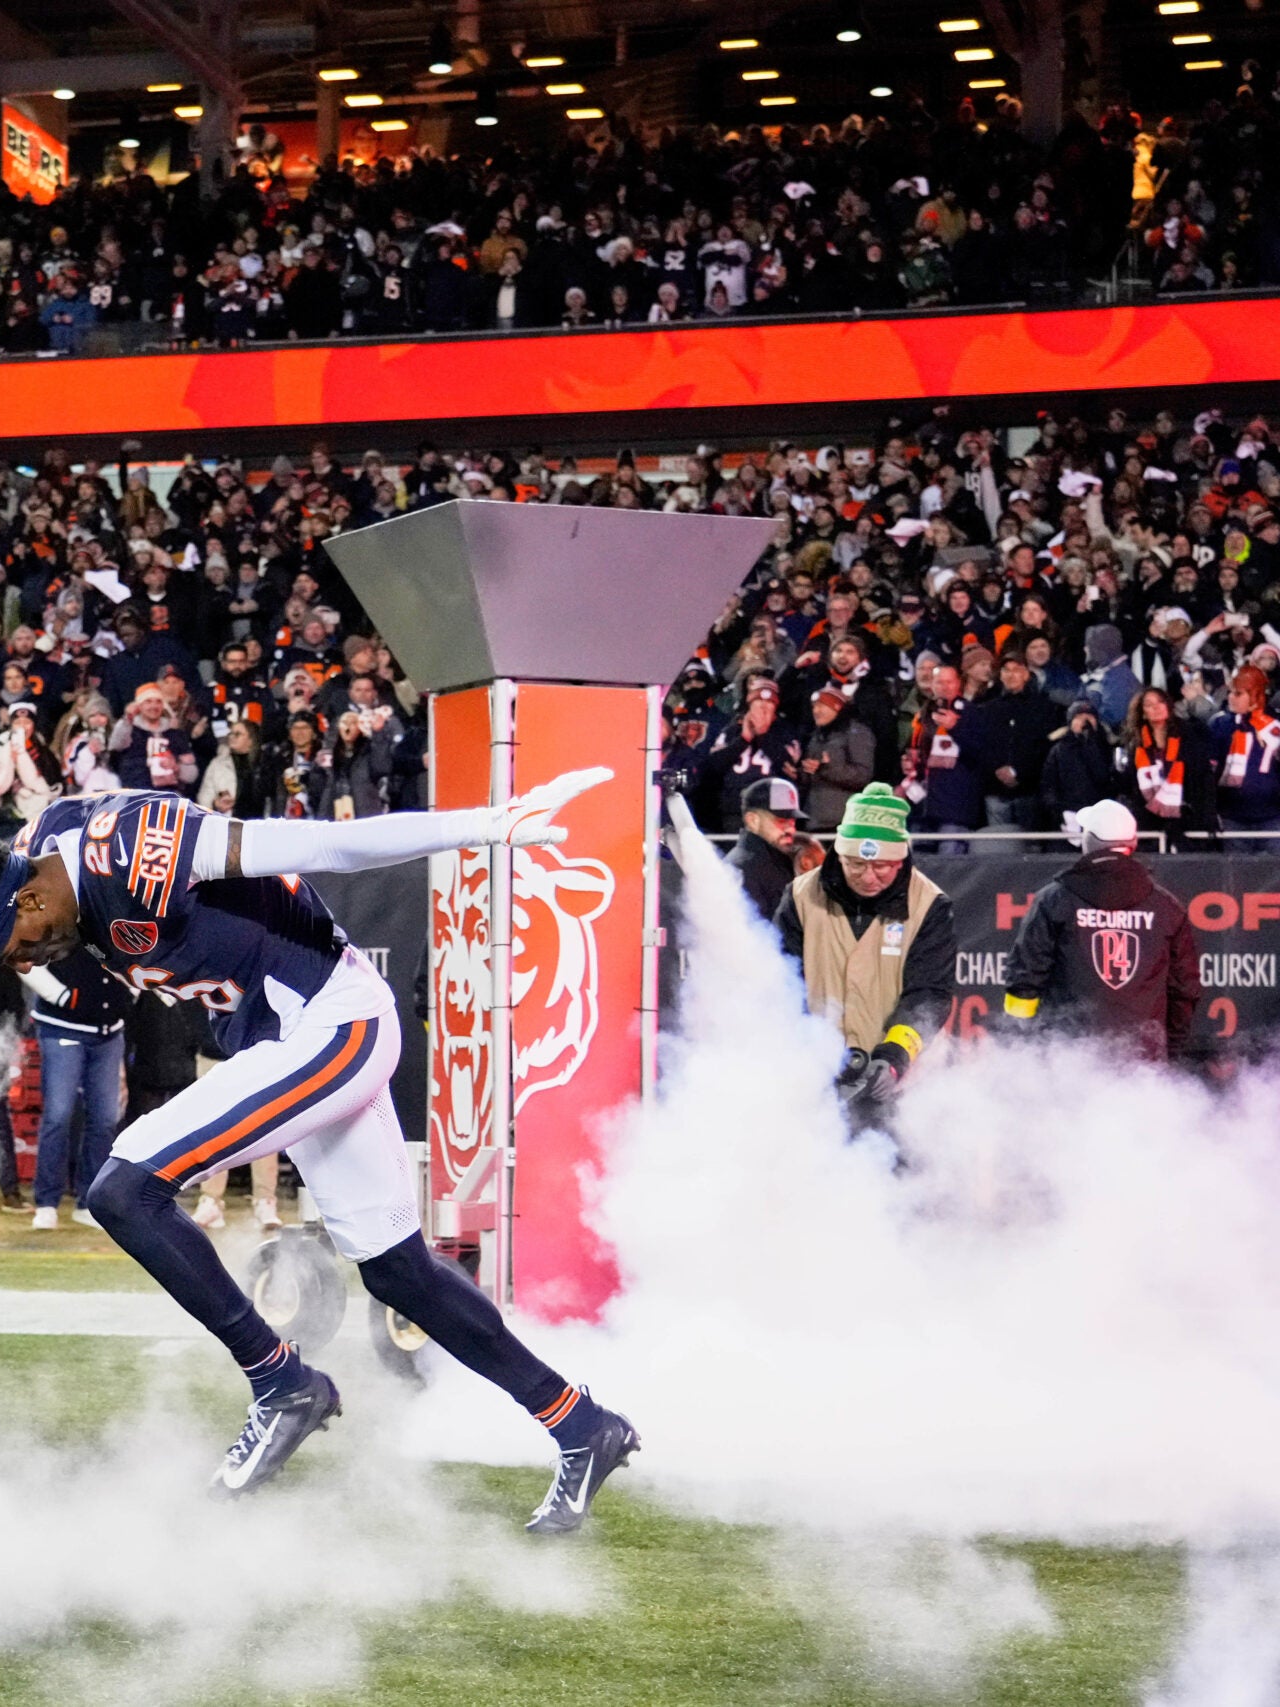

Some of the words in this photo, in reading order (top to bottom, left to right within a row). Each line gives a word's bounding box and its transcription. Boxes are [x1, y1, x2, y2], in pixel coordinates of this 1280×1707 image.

[5, 122, 65, 180] BERS
[83, 810, 120, 877] 26
[138, 825, 176, 884] GSH
[1076, 908, 1154, 931] SECURITY
[1187, 891, 1280, 932] OF
[1099, 930, 1132, 981] P4
[1199, 952, 1277, 988] GURSKI
